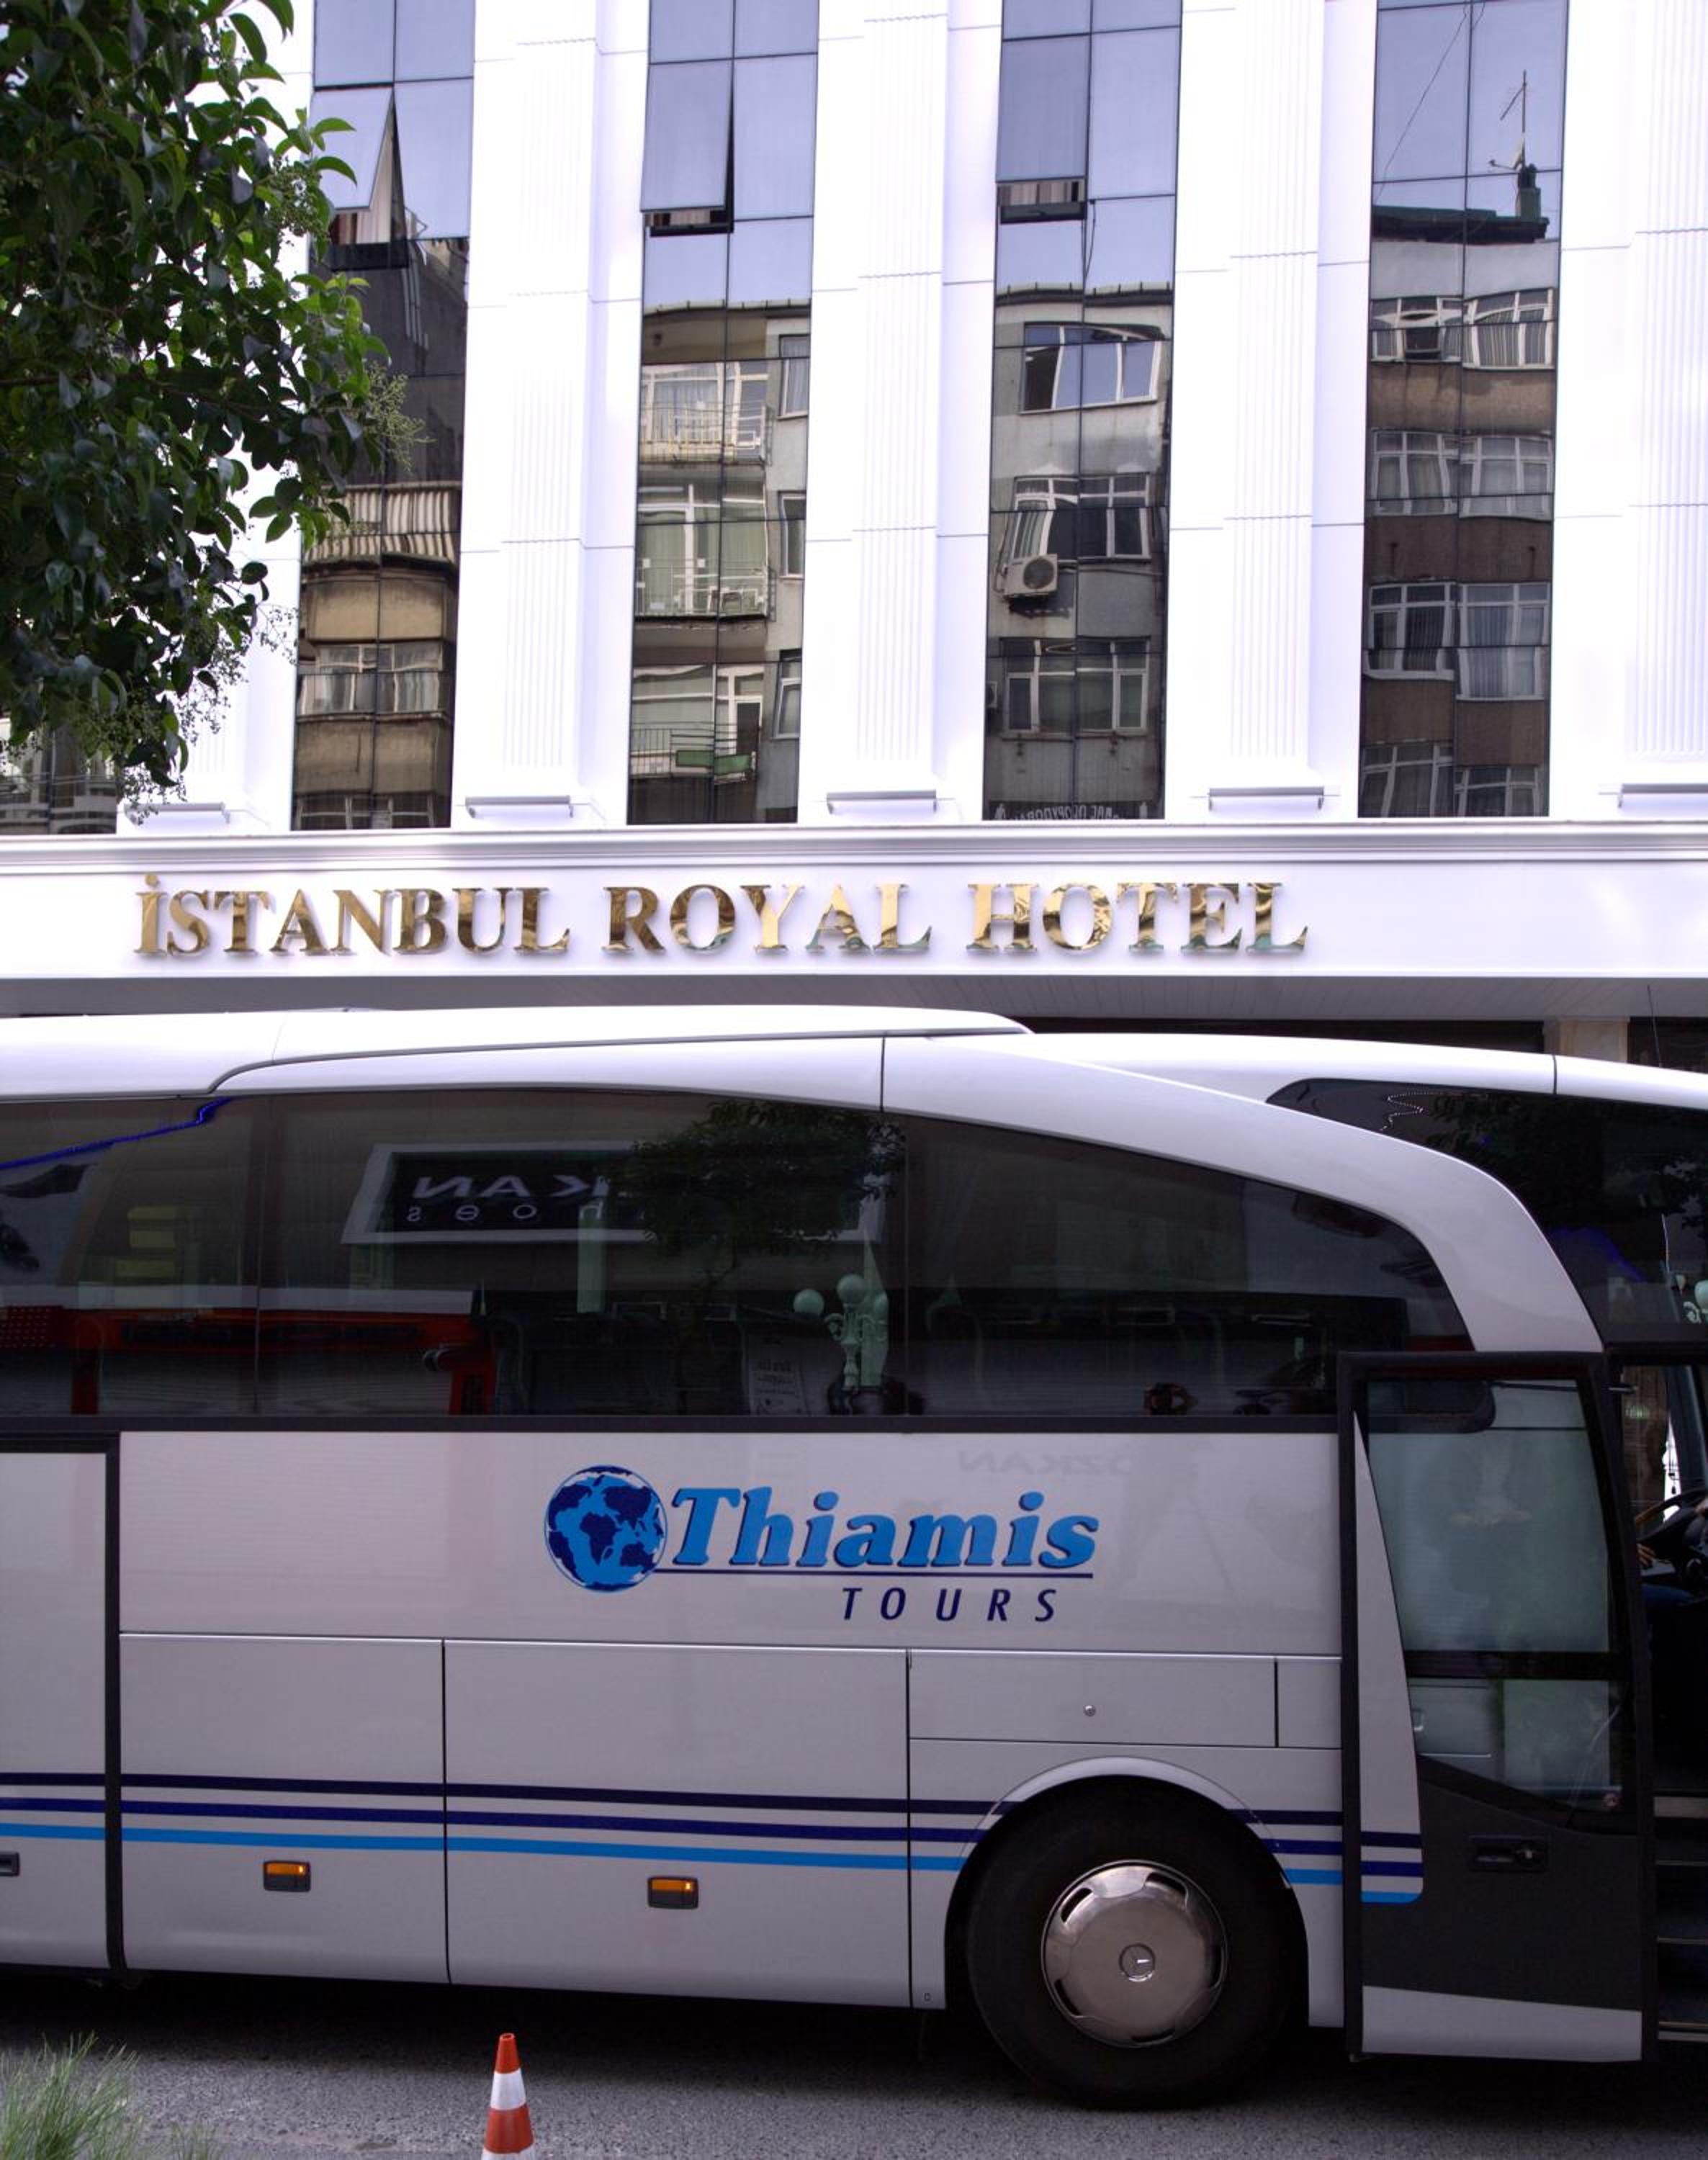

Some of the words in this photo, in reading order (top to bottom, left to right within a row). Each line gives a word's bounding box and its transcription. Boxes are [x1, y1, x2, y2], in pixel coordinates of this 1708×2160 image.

[133, 873, 571, 956] İSTANBUL
[603, 883, 932, 955] ROYAL
[966, 882, 1308, 955] HOTEL
[672, 1486, 1099, 1569] Thiamis
[842, 1587, 1056, 1623] TOURS
